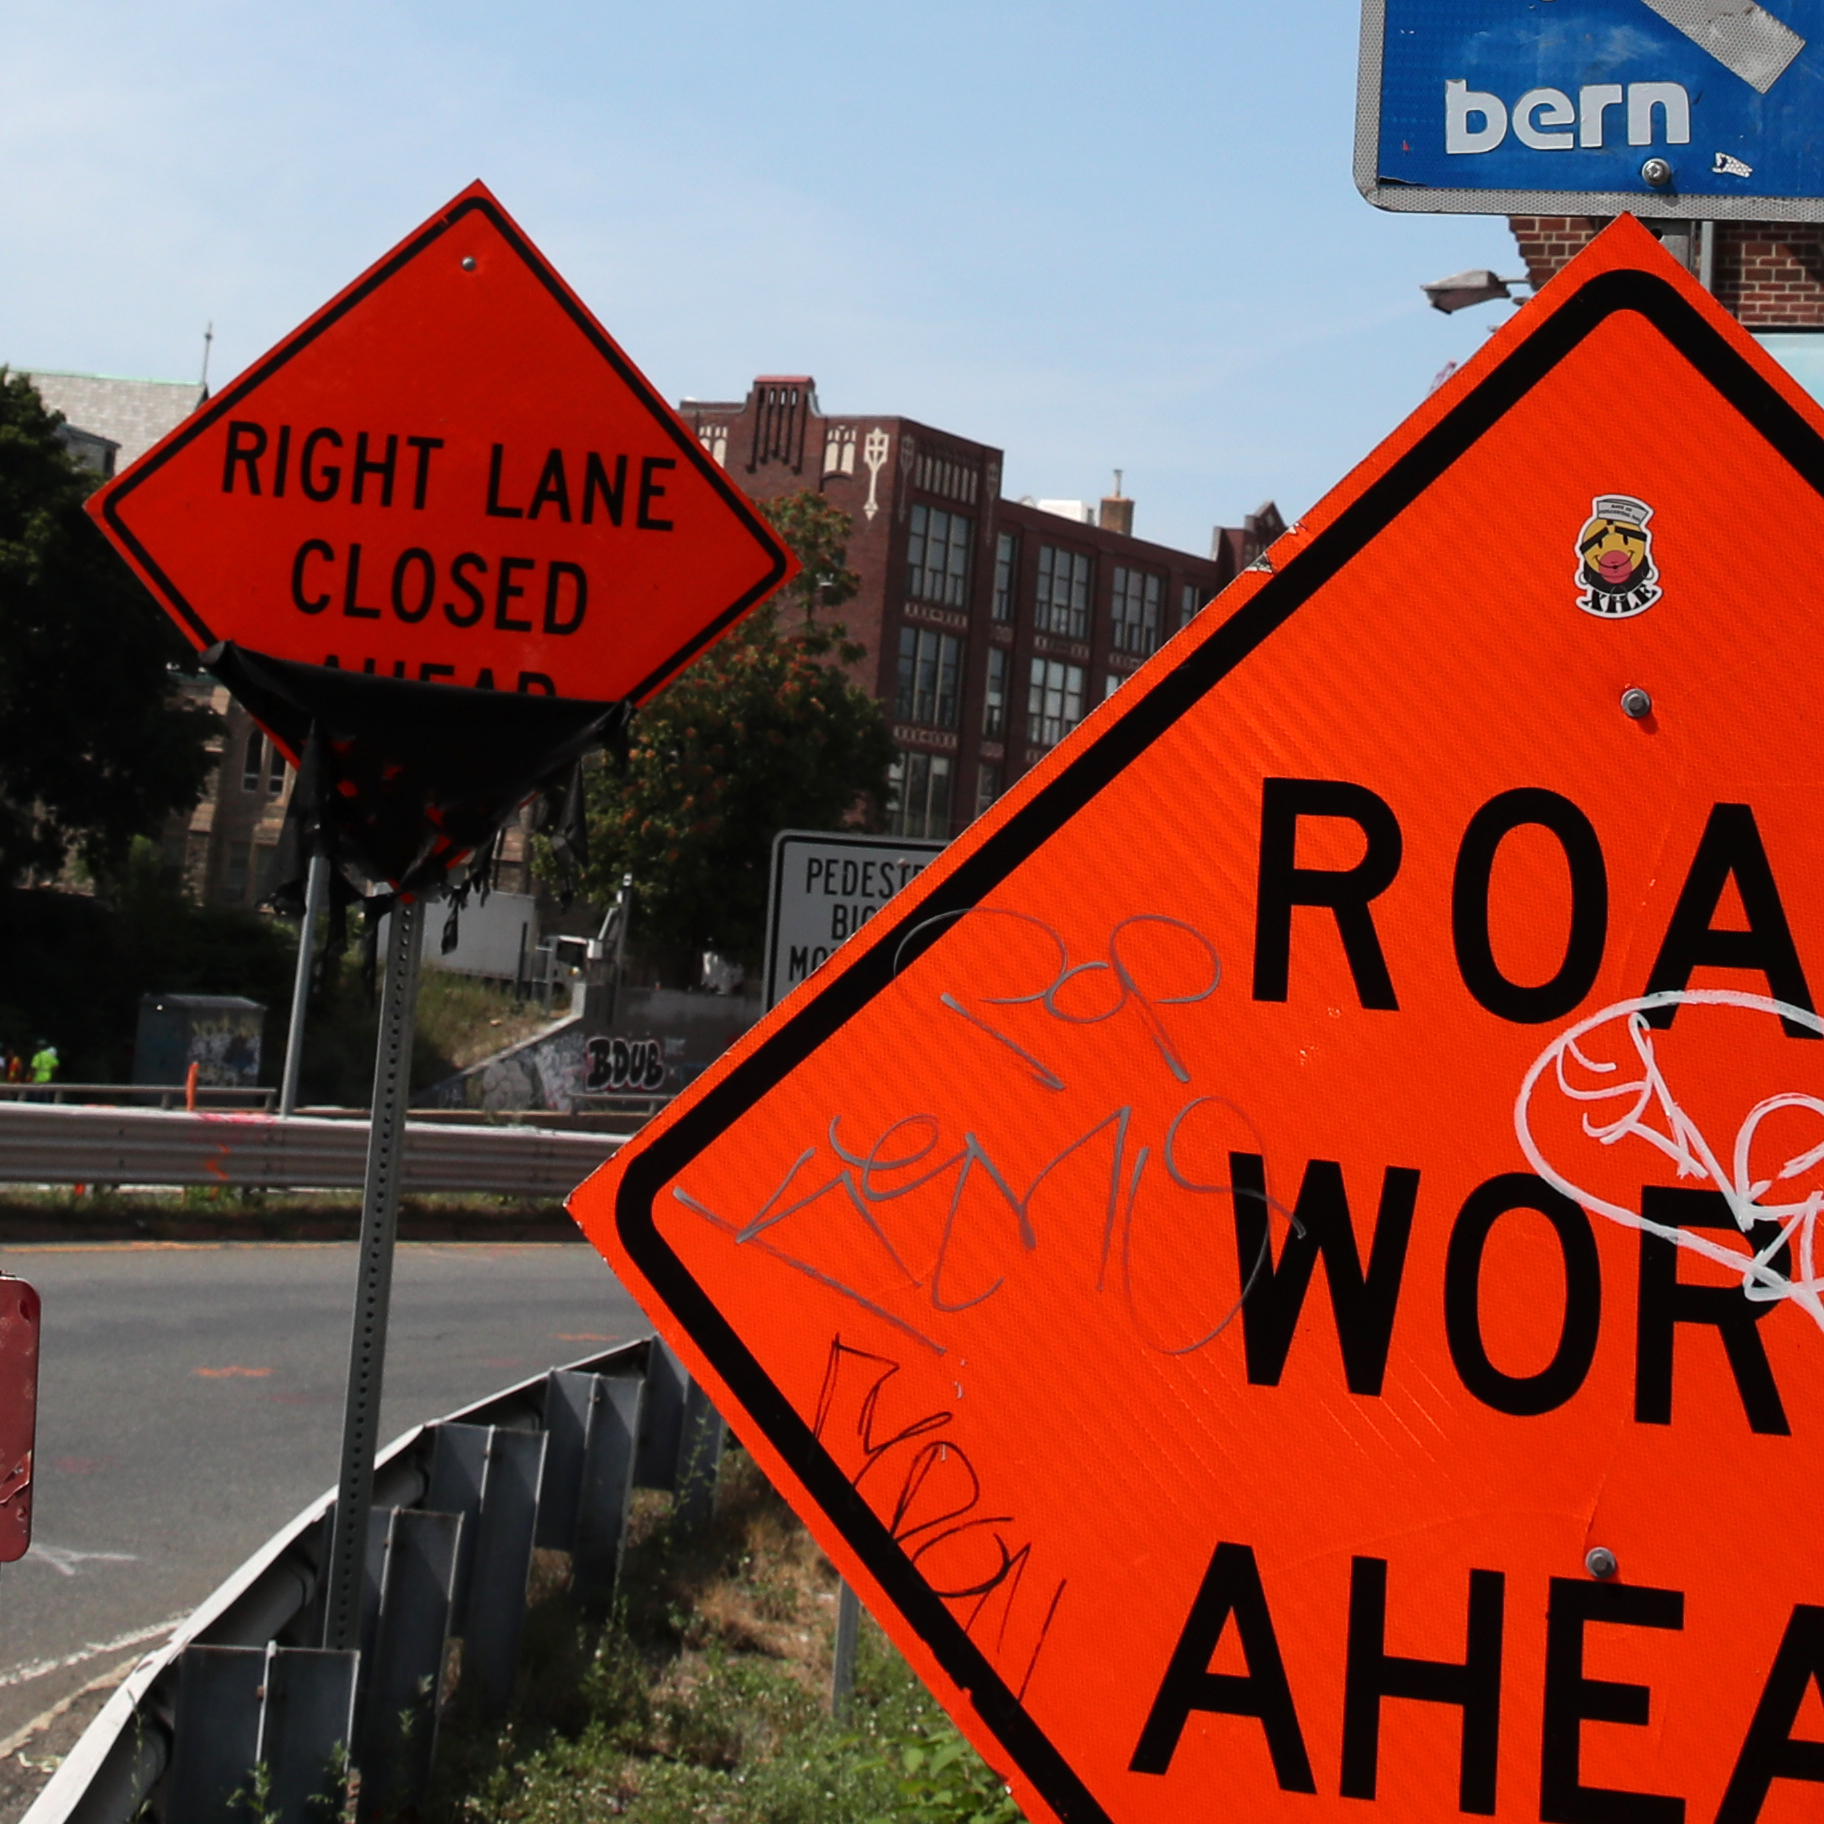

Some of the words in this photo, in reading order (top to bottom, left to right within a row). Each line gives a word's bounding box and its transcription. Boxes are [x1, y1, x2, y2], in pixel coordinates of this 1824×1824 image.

[1444, 78, 1691, 155] bern
[221, 420, 445, 511] RIGHT
[485, 443, 677, 533] LANE
[290, 538, 588, 636] CLOSED
[586, 1036, 666, 1092] BDUB
